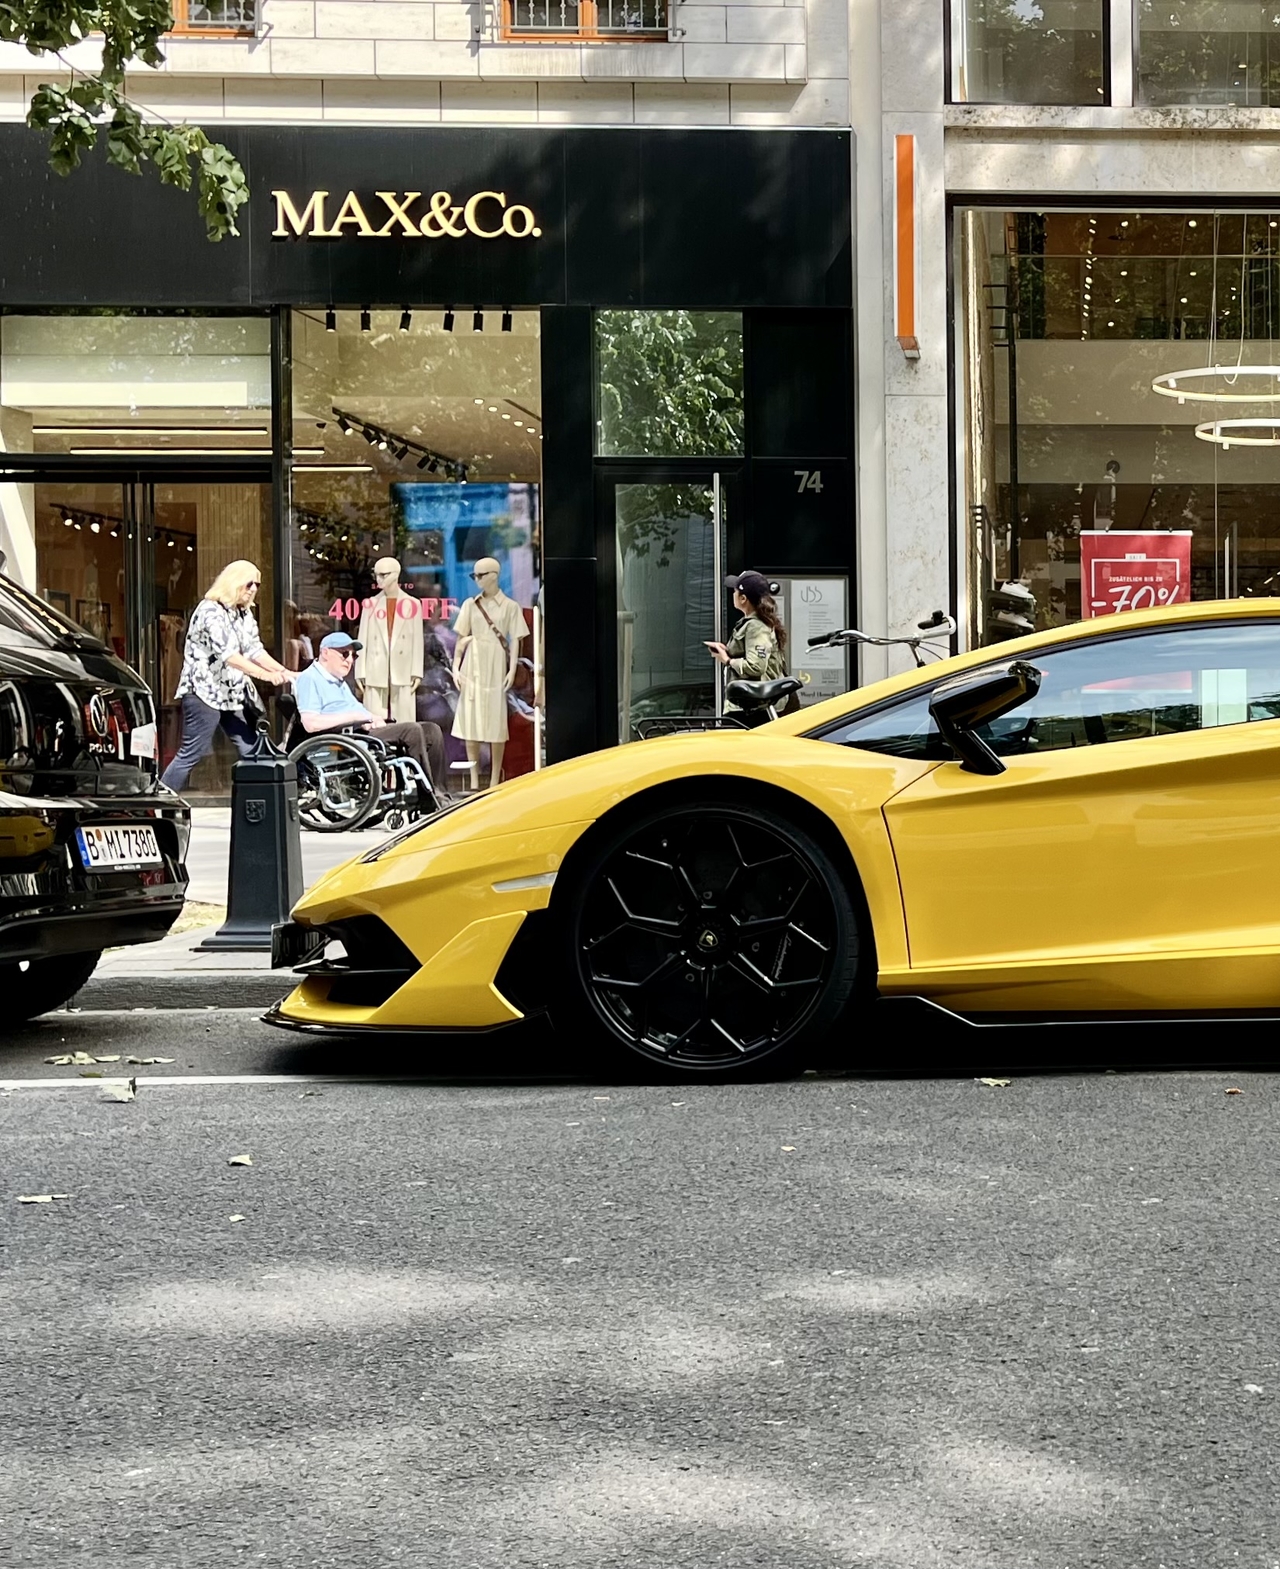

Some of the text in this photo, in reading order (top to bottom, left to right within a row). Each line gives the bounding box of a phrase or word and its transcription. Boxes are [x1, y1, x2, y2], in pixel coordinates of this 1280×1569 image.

[271, 190, 542, 238] MAX&Co.
[794, 470, 824, 493] 74
[328, 597, 458, 621] 40% OFF
[89, 742, 116, 754] POLO
